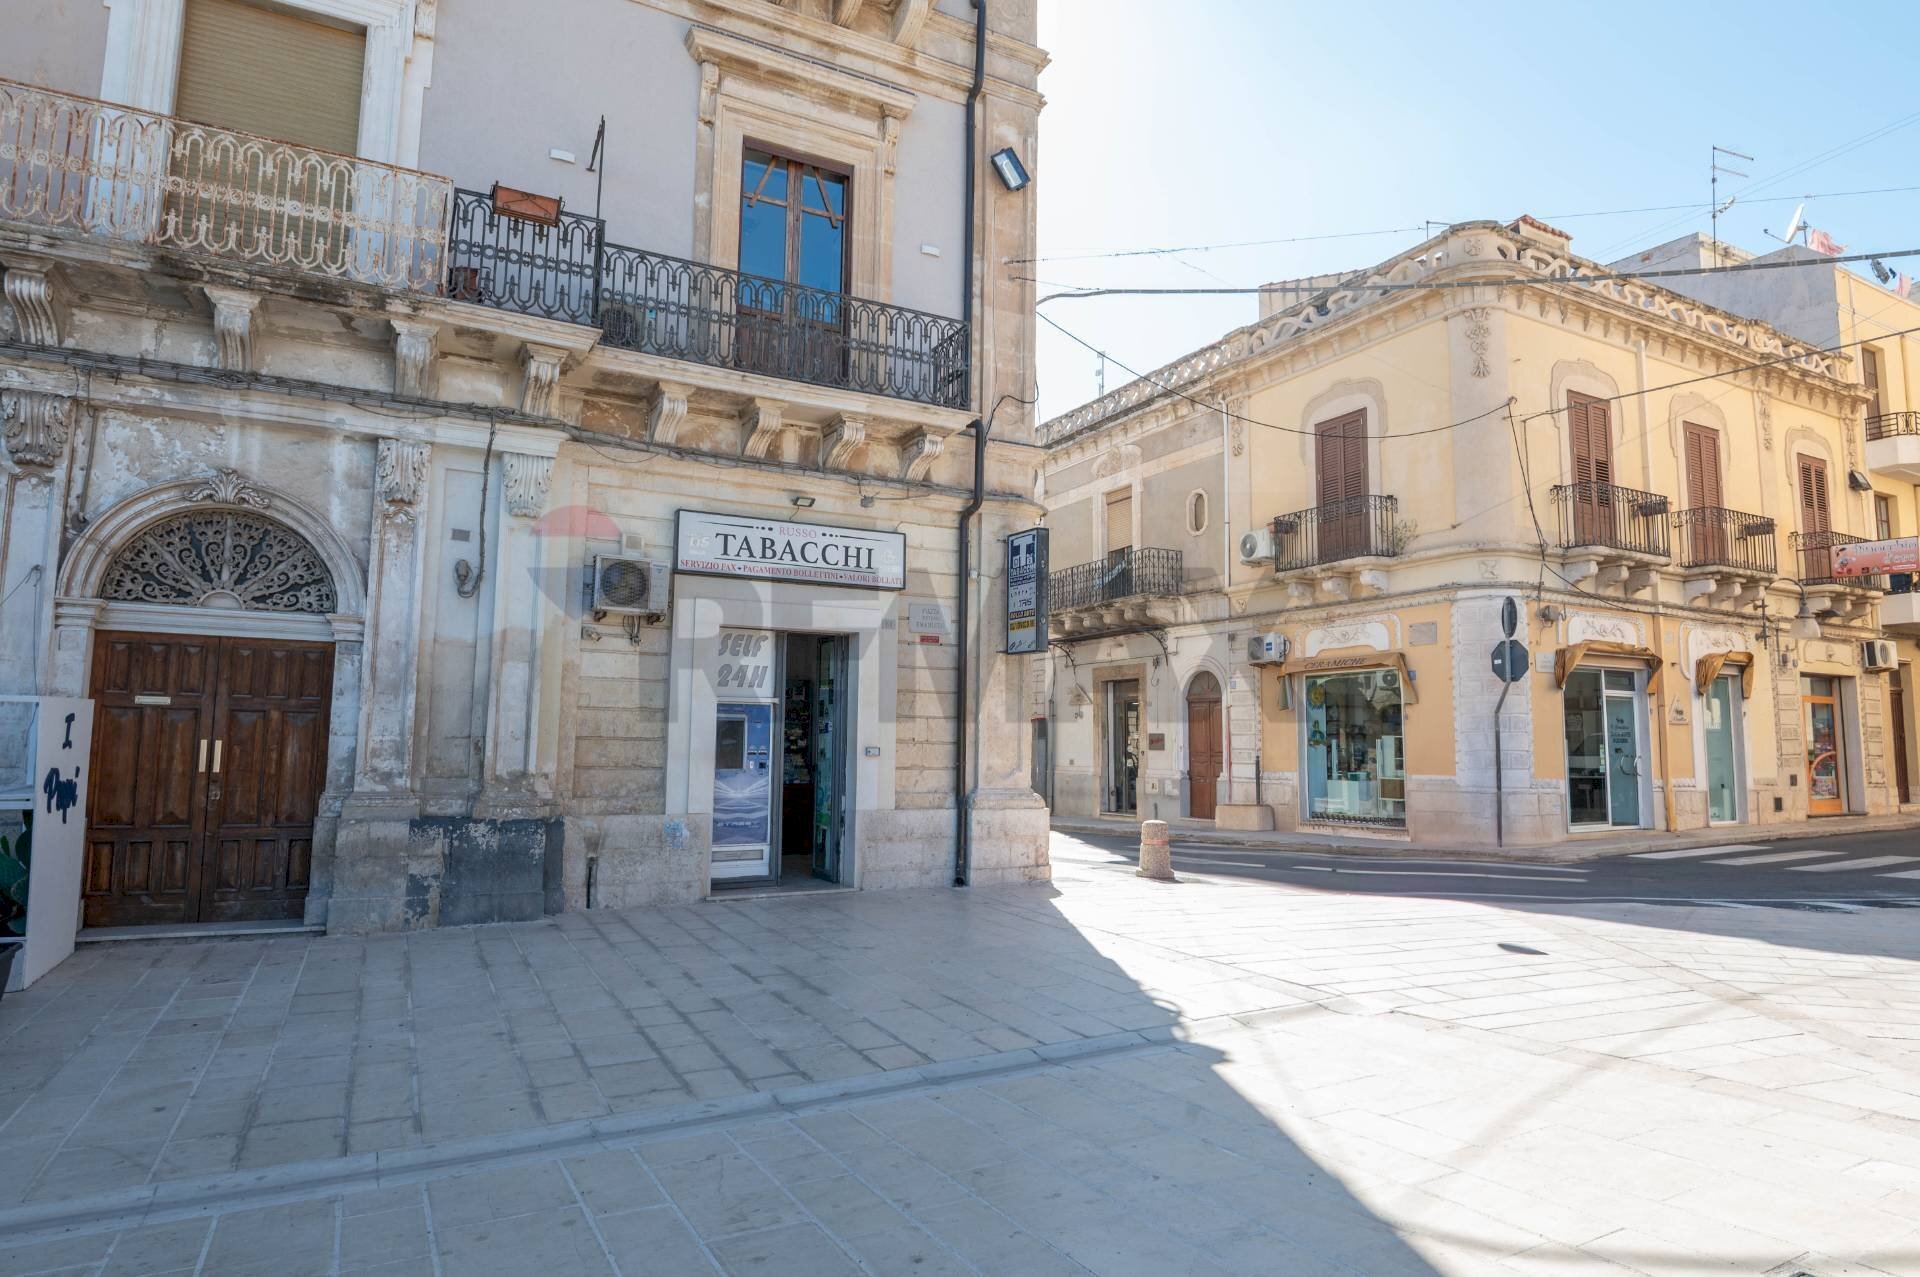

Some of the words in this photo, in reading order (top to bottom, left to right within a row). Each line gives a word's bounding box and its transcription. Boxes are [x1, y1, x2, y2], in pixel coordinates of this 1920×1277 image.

[778, 526, 818, 539] RUSSO
[715, 532, 875, 570] TABACCHI
[680, 559, 720, 570] SERVIZIO
[721, 563, 737, 571] FAX
[743, 564, 792, 576] PAGAMENTO
[793, 569, 839, 580] BOLLETTINI
[843, 574, 870, 583] VALORI
[718, 632, 769, 657] SELF
[1304, 656, 1367, 670] CERAMICHE
[717, 663, 769, 688] 24H
